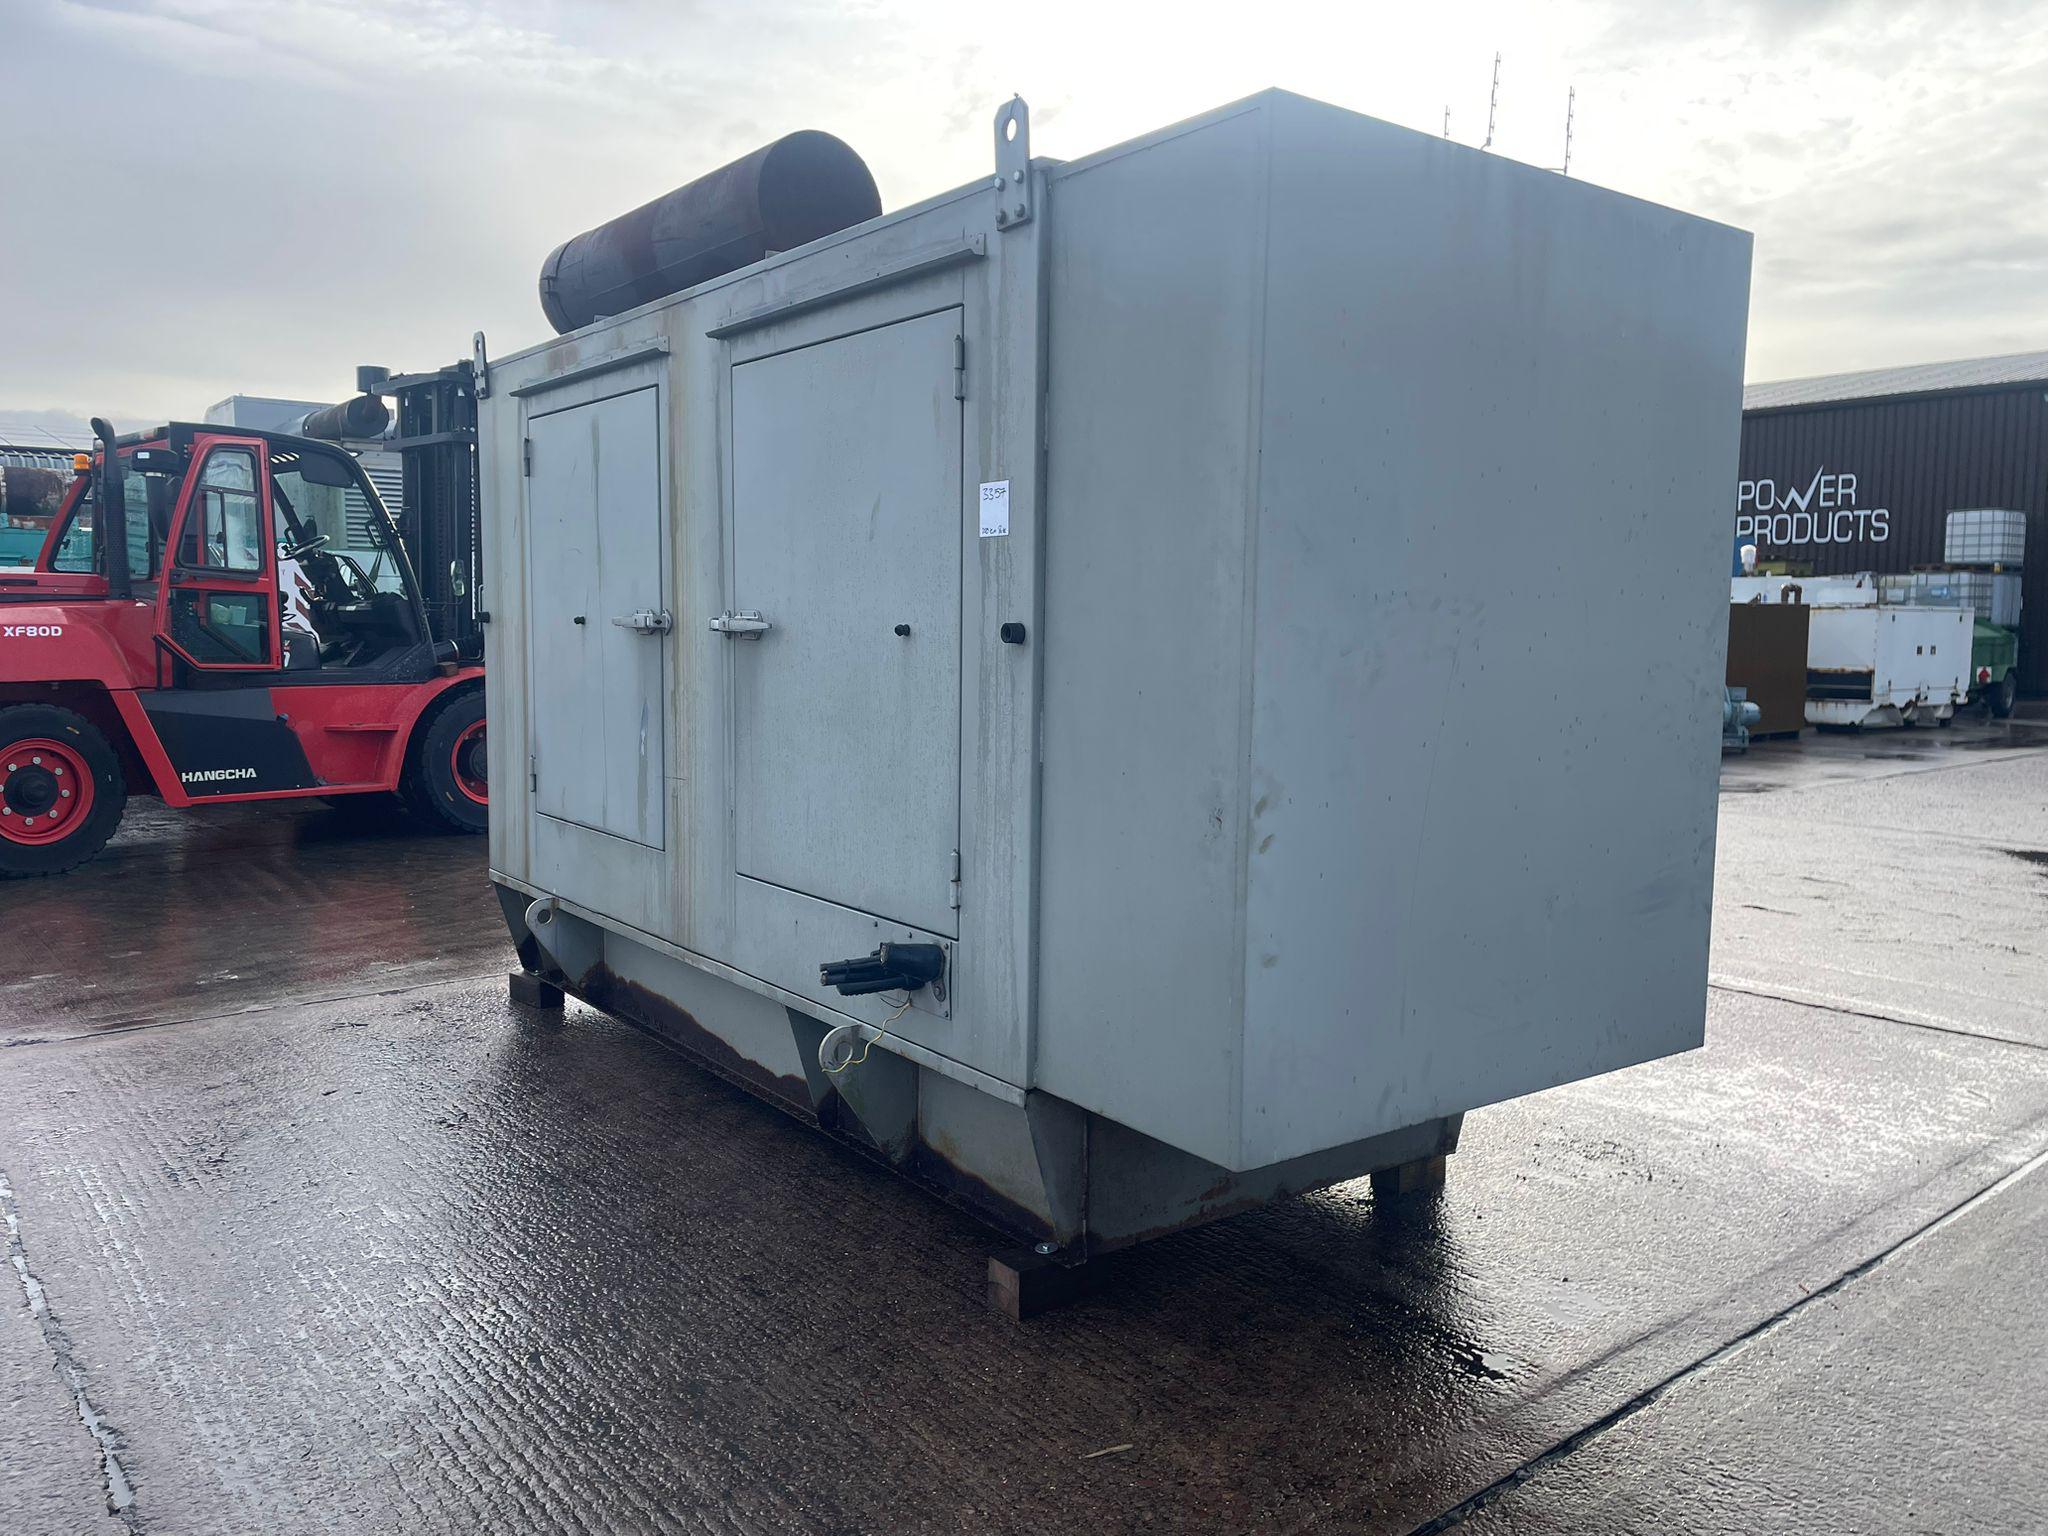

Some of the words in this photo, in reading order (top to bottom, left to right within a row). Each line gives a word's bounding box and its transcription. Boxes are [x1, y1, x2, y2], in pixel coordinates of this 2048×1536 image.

[1738, 465, 1857, 512] POWER
[1736, 508, 1890, 546] PRODUCTS
[3, 625, 63, 637] XF80D
[181, 767, 257, 783] HANGCHA
